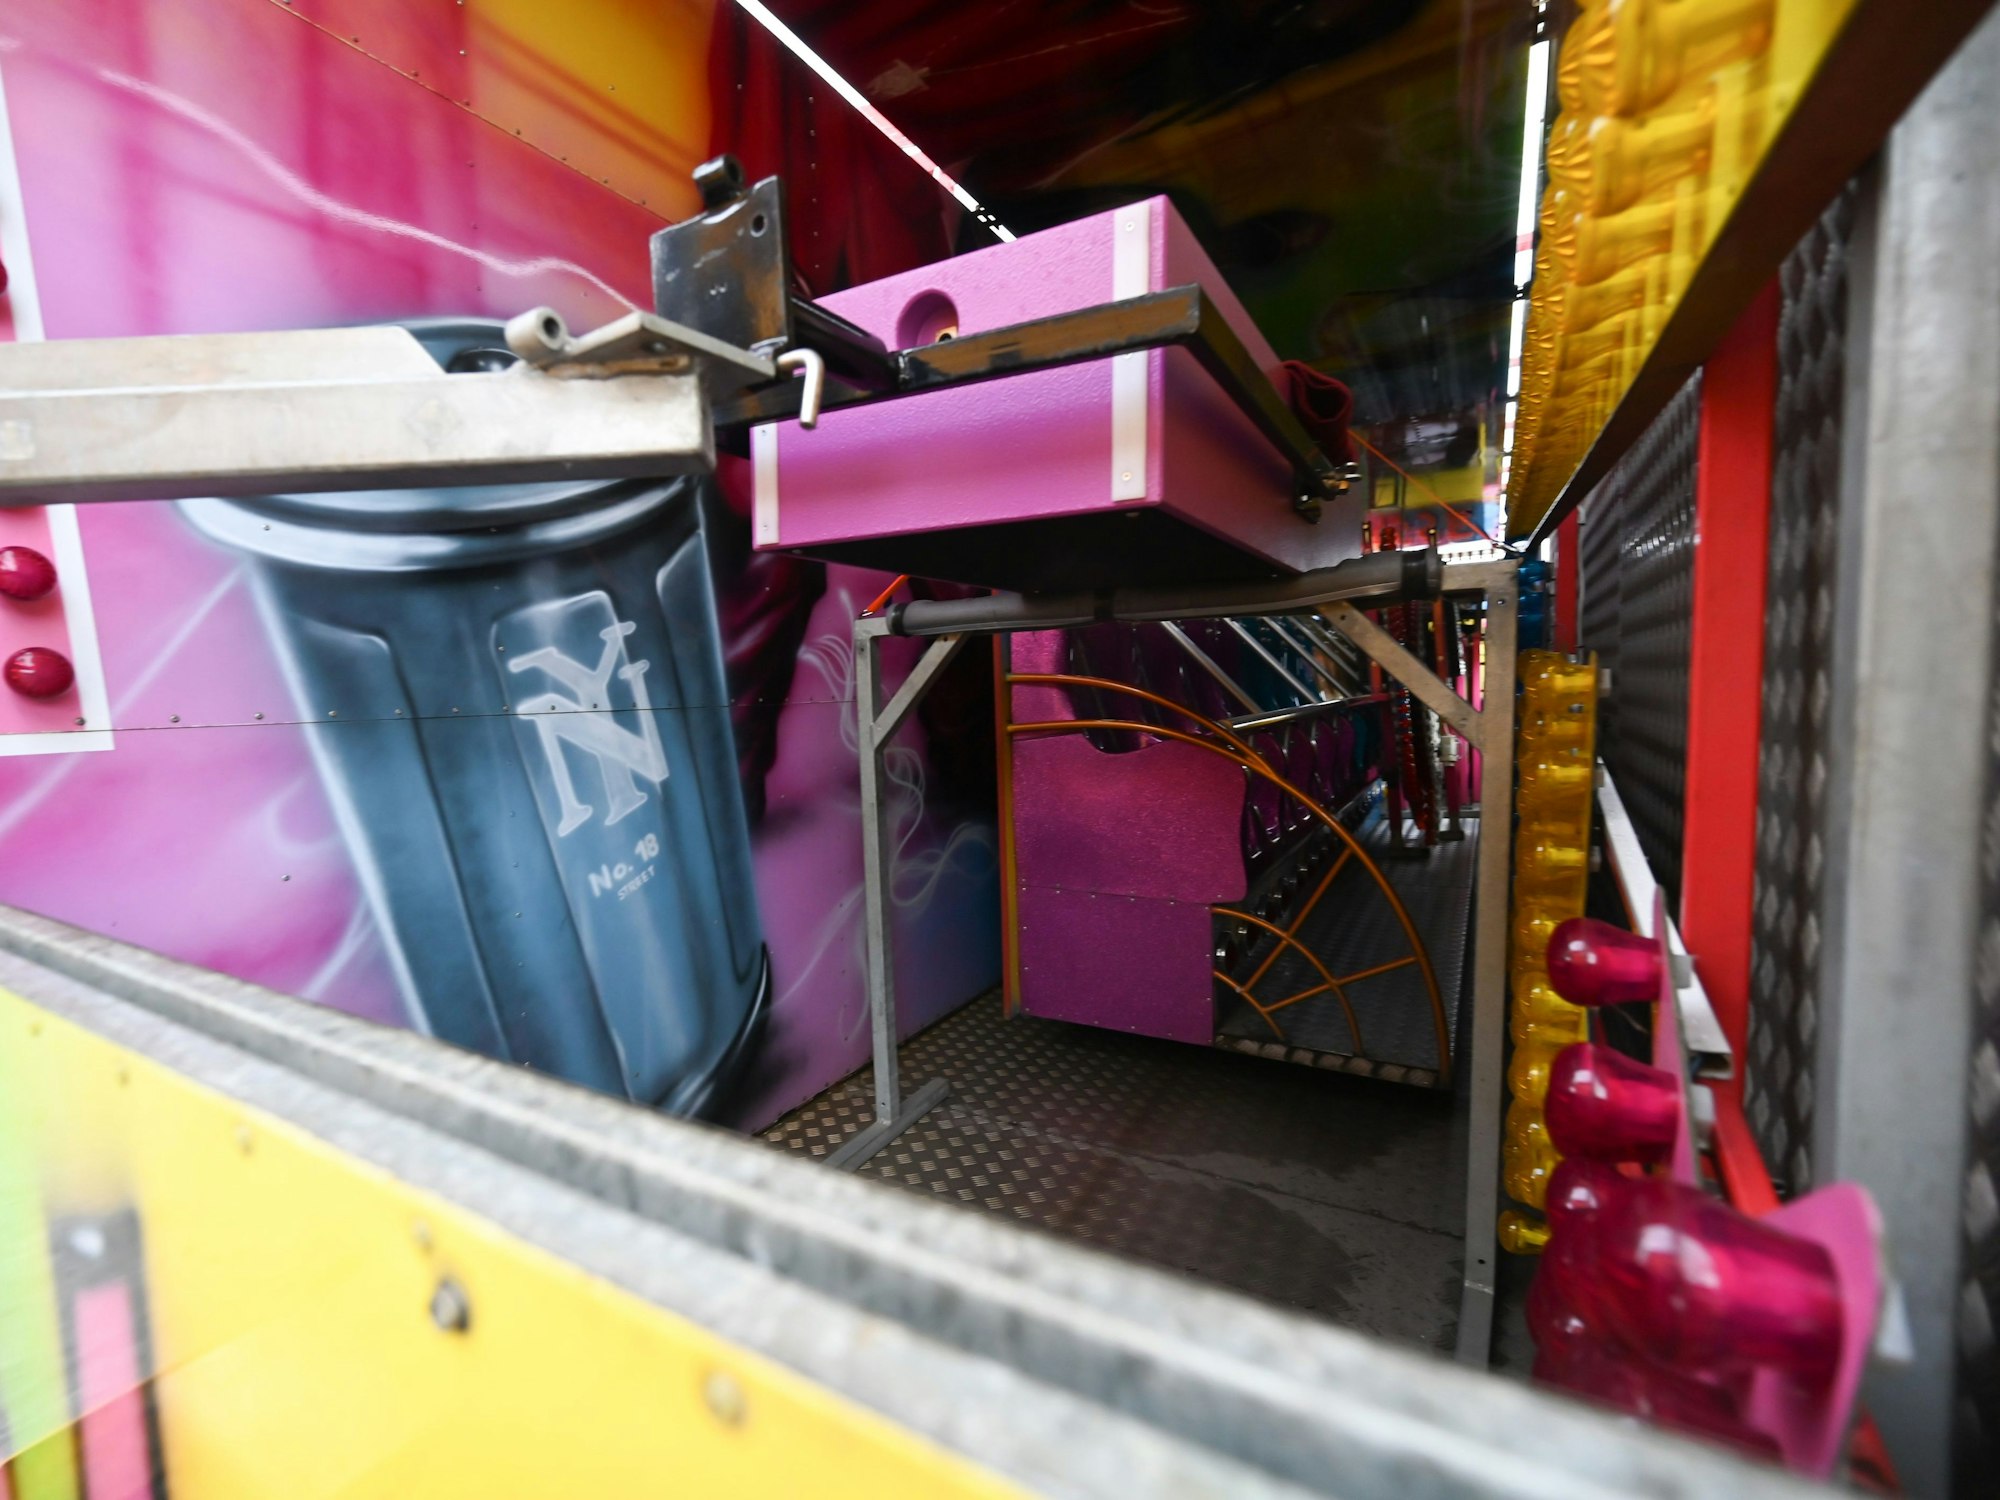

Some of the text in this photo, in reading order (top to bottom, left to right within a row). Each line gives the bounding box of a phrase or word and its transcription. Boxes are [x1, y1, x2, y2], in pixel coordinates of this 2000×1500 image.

[588, 832, 660, 898] No. 18
[617, 864, 655, 901] STREET
